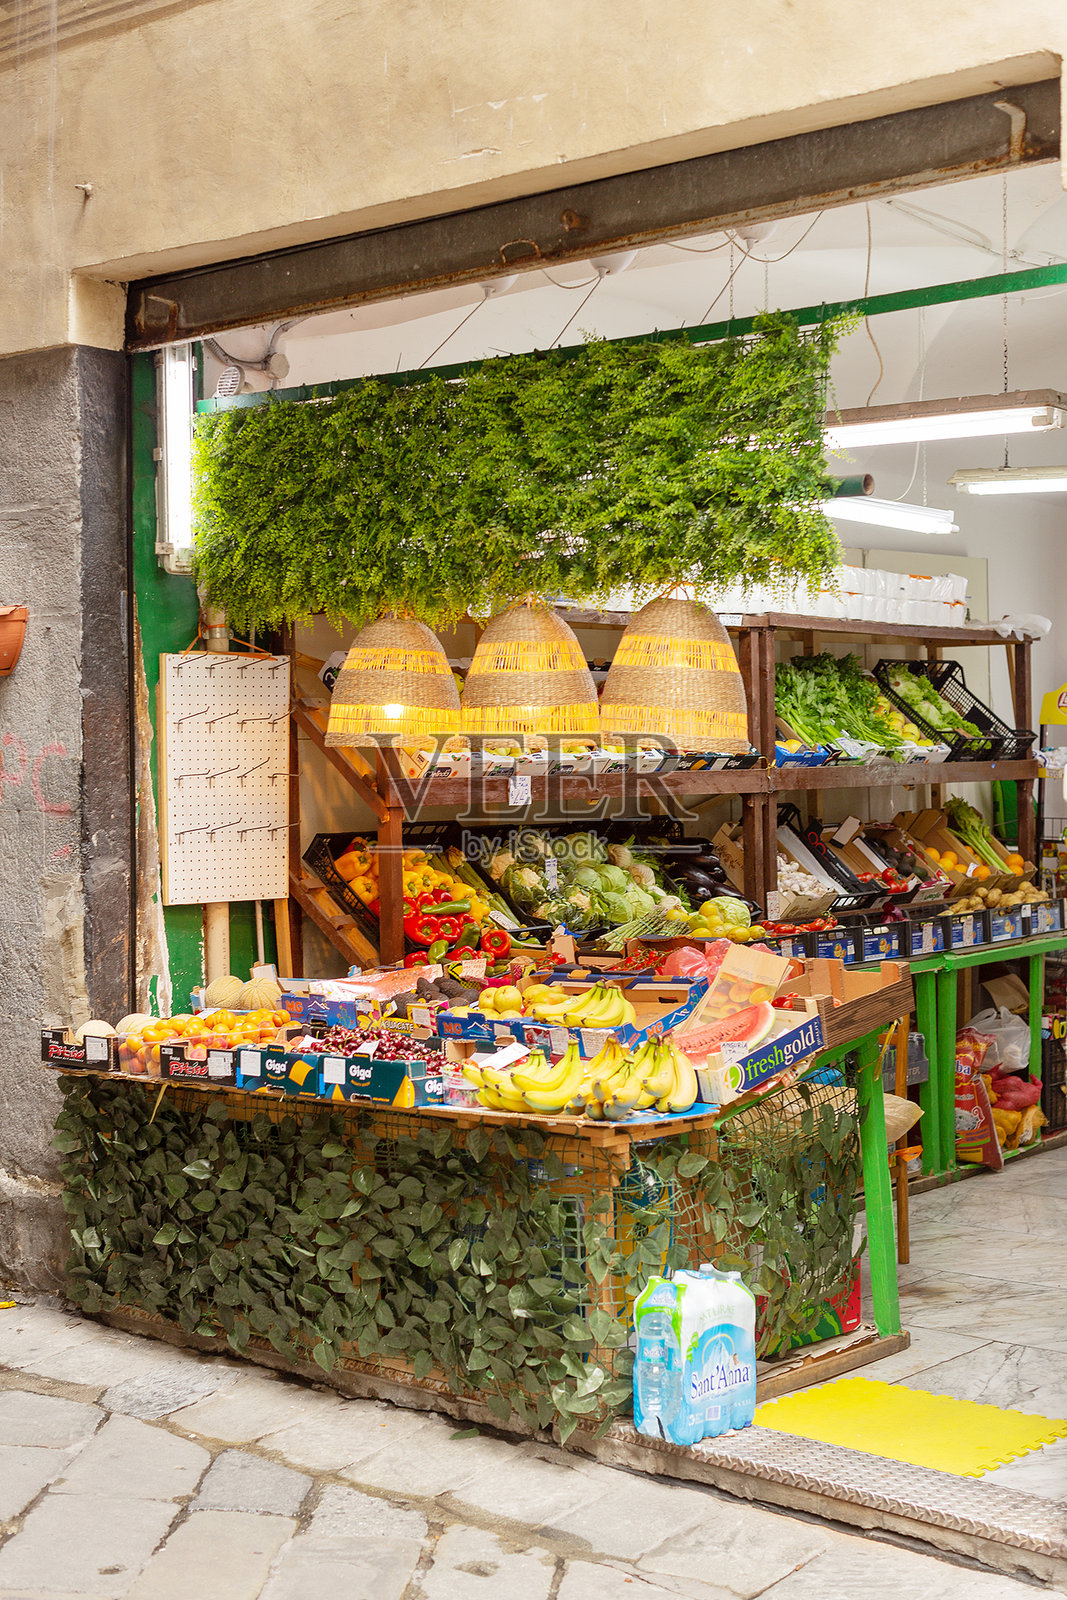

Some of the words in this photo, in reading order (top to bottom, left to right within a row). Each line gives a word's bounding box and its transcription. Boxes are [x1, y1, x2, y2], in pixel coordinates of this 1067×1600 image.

[285, 1001, 303, 1013] MG
[442, 1022, 462, 1035] MG
[646, 1021, 664, 1038] MG
[745, 1025, 815, 1082] freshgold
[265, 1058, 287, 1073] Giga
[349, 1065, 373, 1080] Giga
[425, 1079, 443, 1095] Gig
[691, 1364, 749, 1399] Sant'Anna
